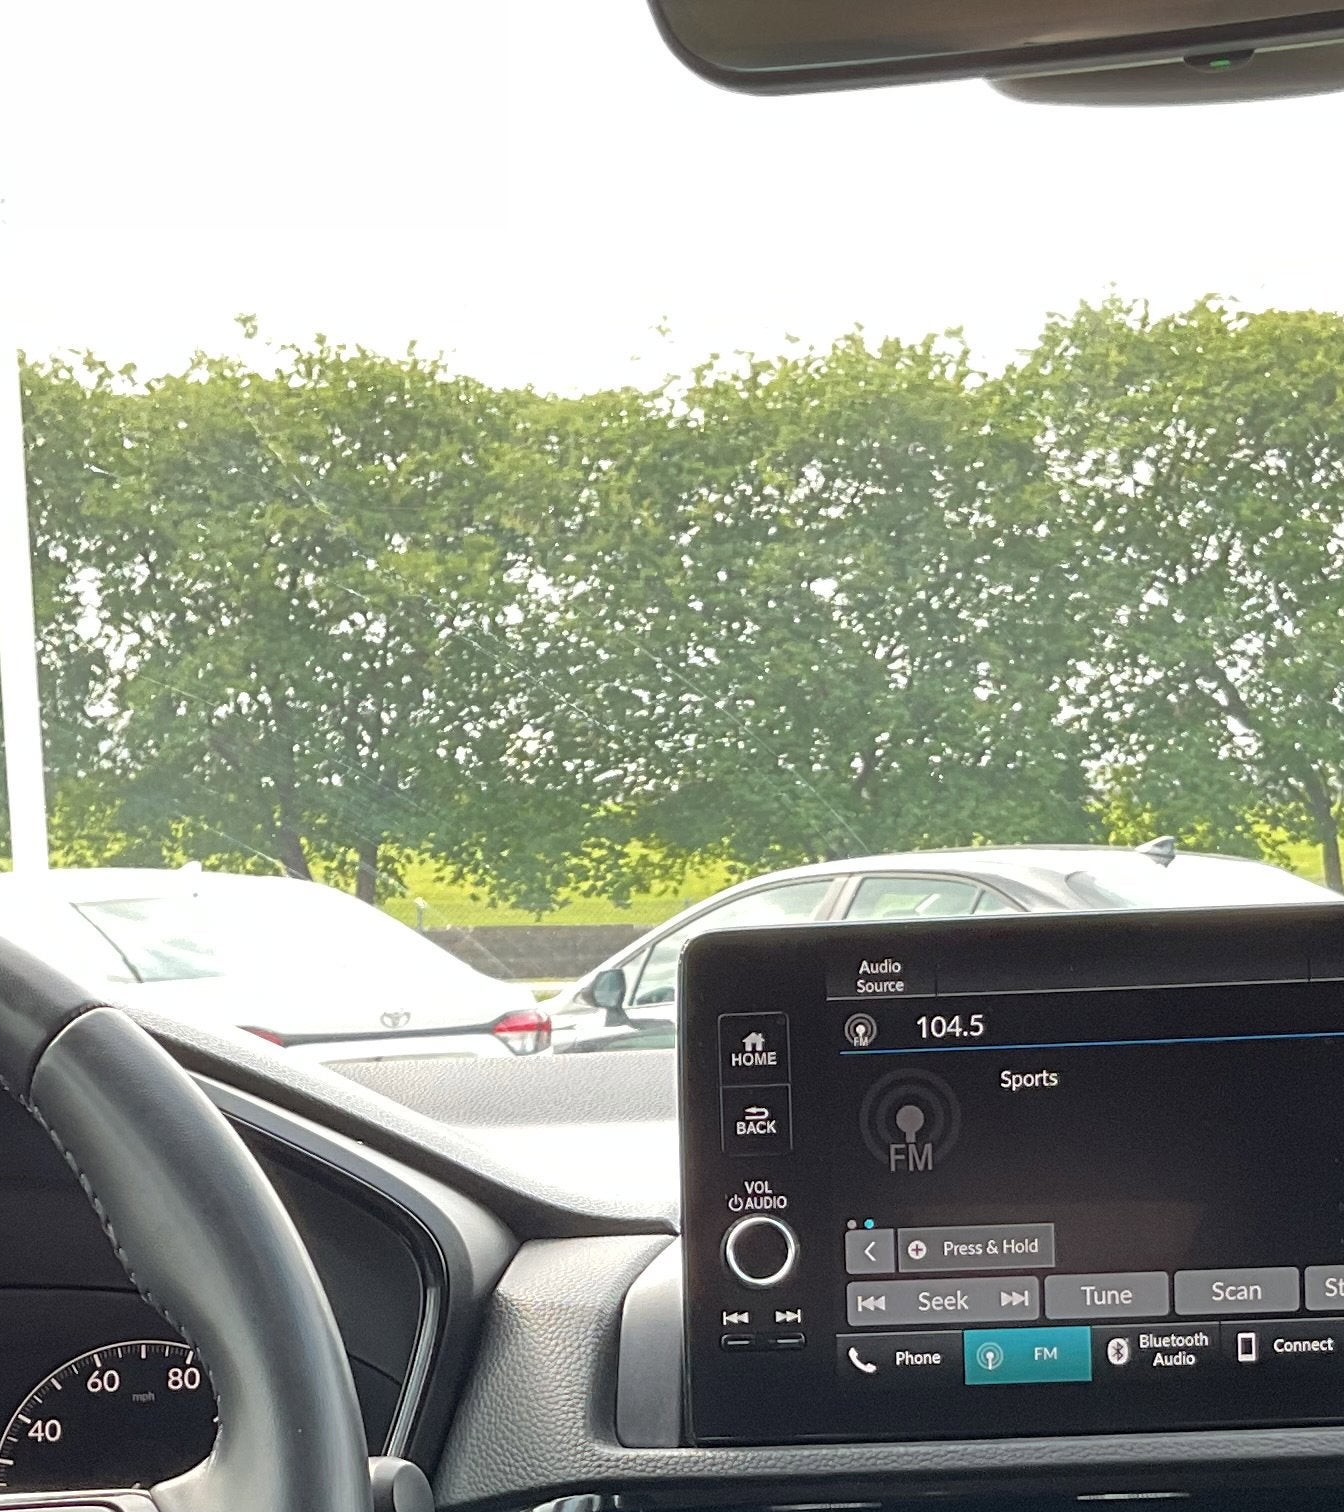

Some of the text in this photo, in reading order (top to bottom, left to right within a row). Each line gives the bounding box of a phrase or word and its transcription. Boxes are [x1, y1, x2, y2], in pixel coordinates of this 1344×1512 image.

[858, 959, 901, 974] Audio
[856, 977, 905, 993] Source
[915, 1014, 985, 1039] 104.5
[731, 1051, 777, 1067] HOME
[1000, 1070, 1059, 1091] Sports
[736, 1120, 777, 1135] BACK
[889, 1143, 933, 1172] FM
[744, 1181, 773, 1194] VOL
[744, 1195, 787, 1210] AUDIO
[943, 1238, 1039, 1256] Press & Hold
[1081, 1285, 1133, 1306] Tune
[1211, 1281, 1262, 1301] Scan
[918, 1291, 969, 1311] Seek
[1139, 1332, 1209, 1348] Bluetooth
[1273, 1336, 1334, 1353] Connect
[895, 1350, 941, 1366] Phone
[1033, 1347, 1058, 1361] FM
[1152, 1351, 1196, 1366] Audio
[85, 1369, 120, 1394] 60
[167, 1367, 201, 1391] 80
[132, 1390, 155, 1404] mph
[27, 1419, 62, 1443] 40
